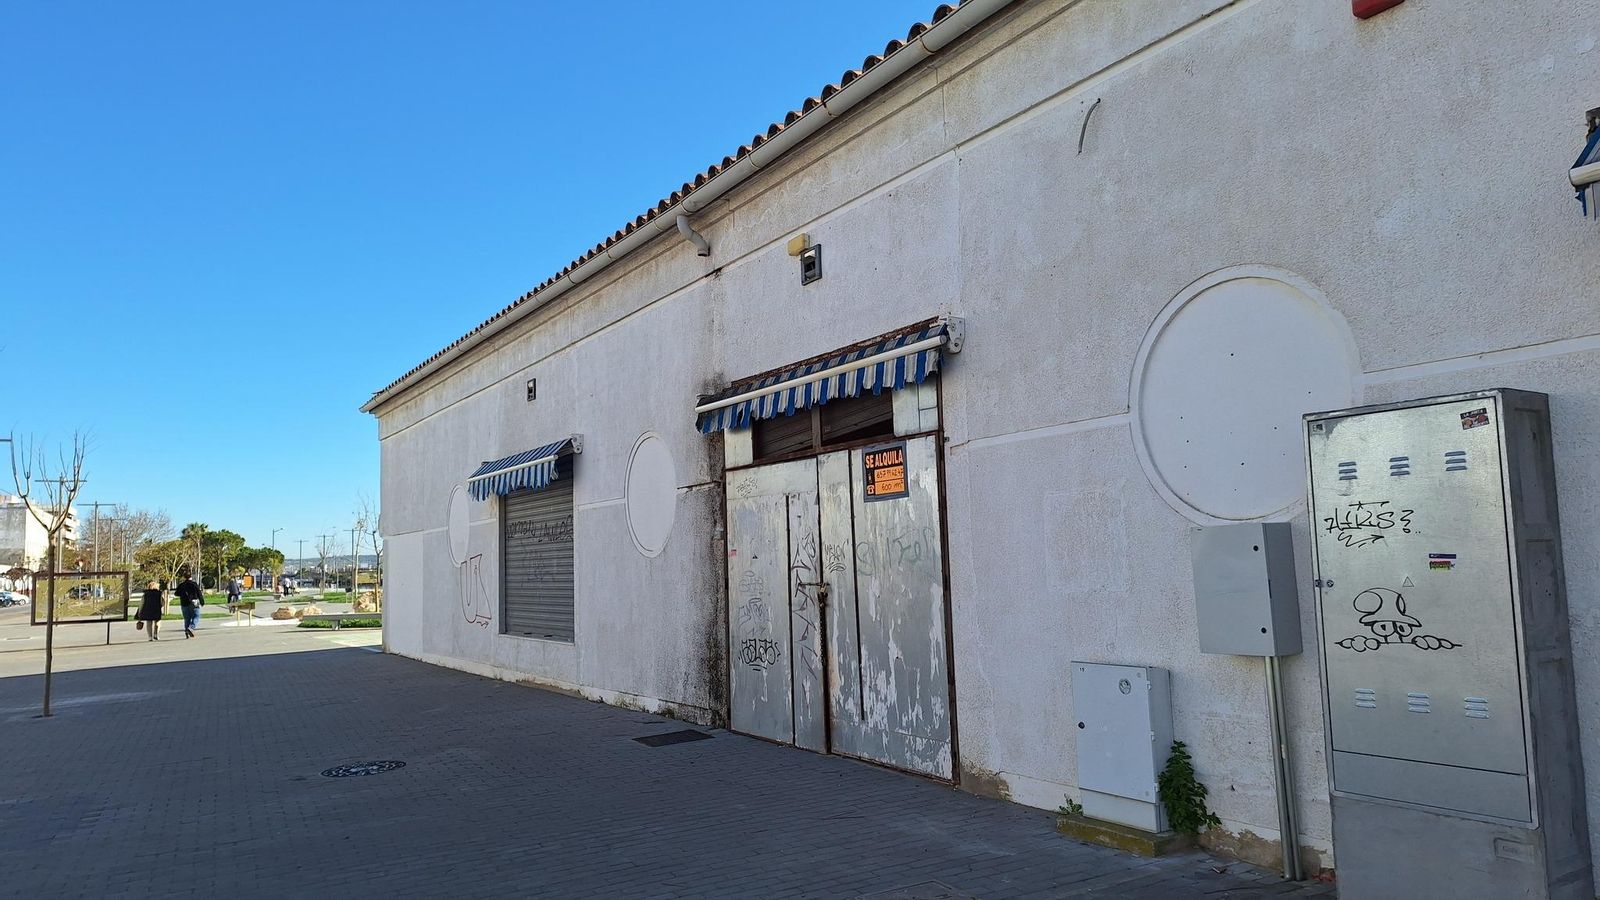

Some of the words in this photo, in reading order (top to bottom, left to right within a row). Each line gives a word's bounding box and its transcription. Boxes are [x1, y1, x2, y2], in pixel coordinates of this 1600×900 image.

[866, 455, 874, 468] SE
[875, 450, 903, 466] ALQUILA
[882, 483, 892, 491] 600
